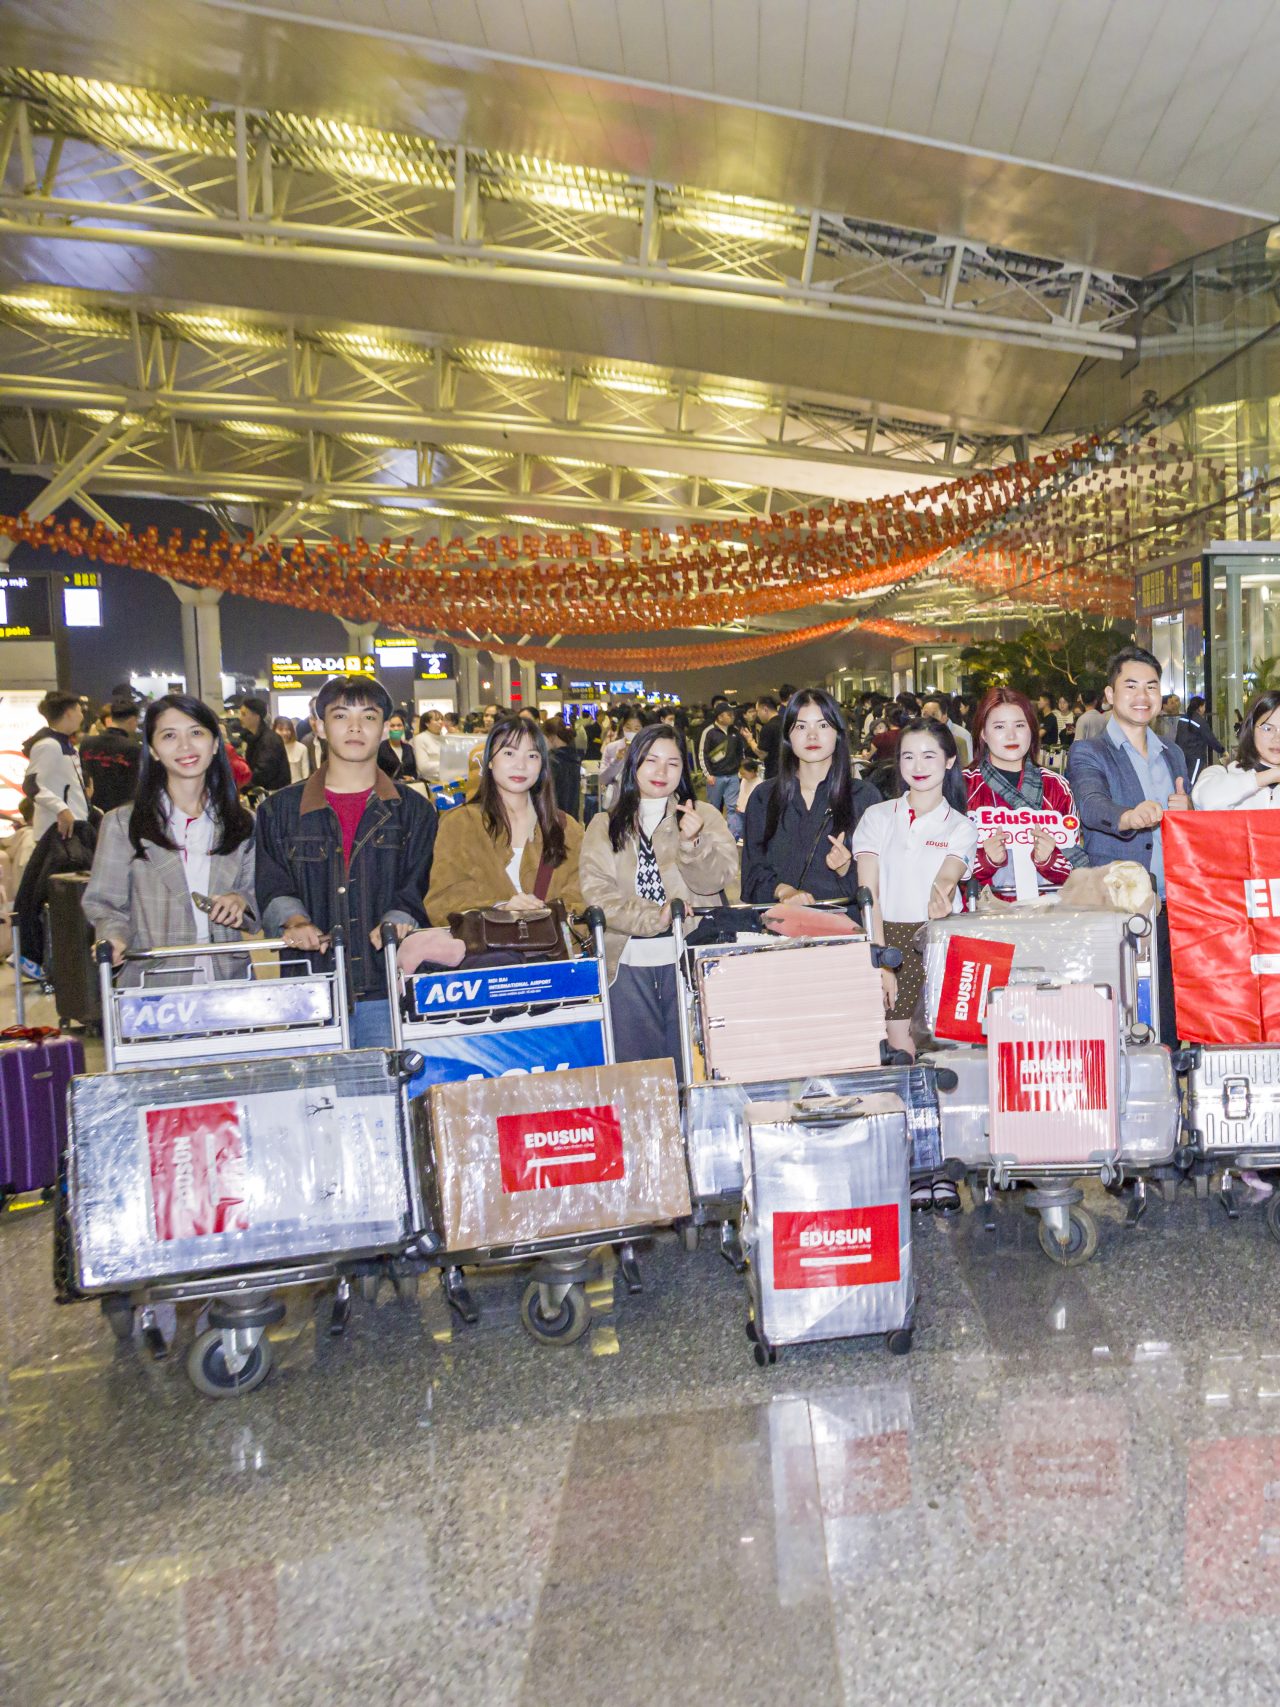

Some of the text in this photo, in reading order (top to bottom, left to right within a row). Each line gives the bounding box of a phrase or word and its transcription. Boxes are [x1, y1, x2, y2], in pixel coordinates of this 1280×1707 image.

[5, 626, 31, 637] point
[428, 658, 441, 674] 2
[981, 811, 1058, 825] EduSun
[425, 979, 482, 1005] ACV
[955, 961, 975, 1021] EDUSUN
[132, 1000, 197, 1029] ACV
[524, 1127, 595, 1149] EDUSUN
[800, 1227, 871, 1248] EDUSUN
